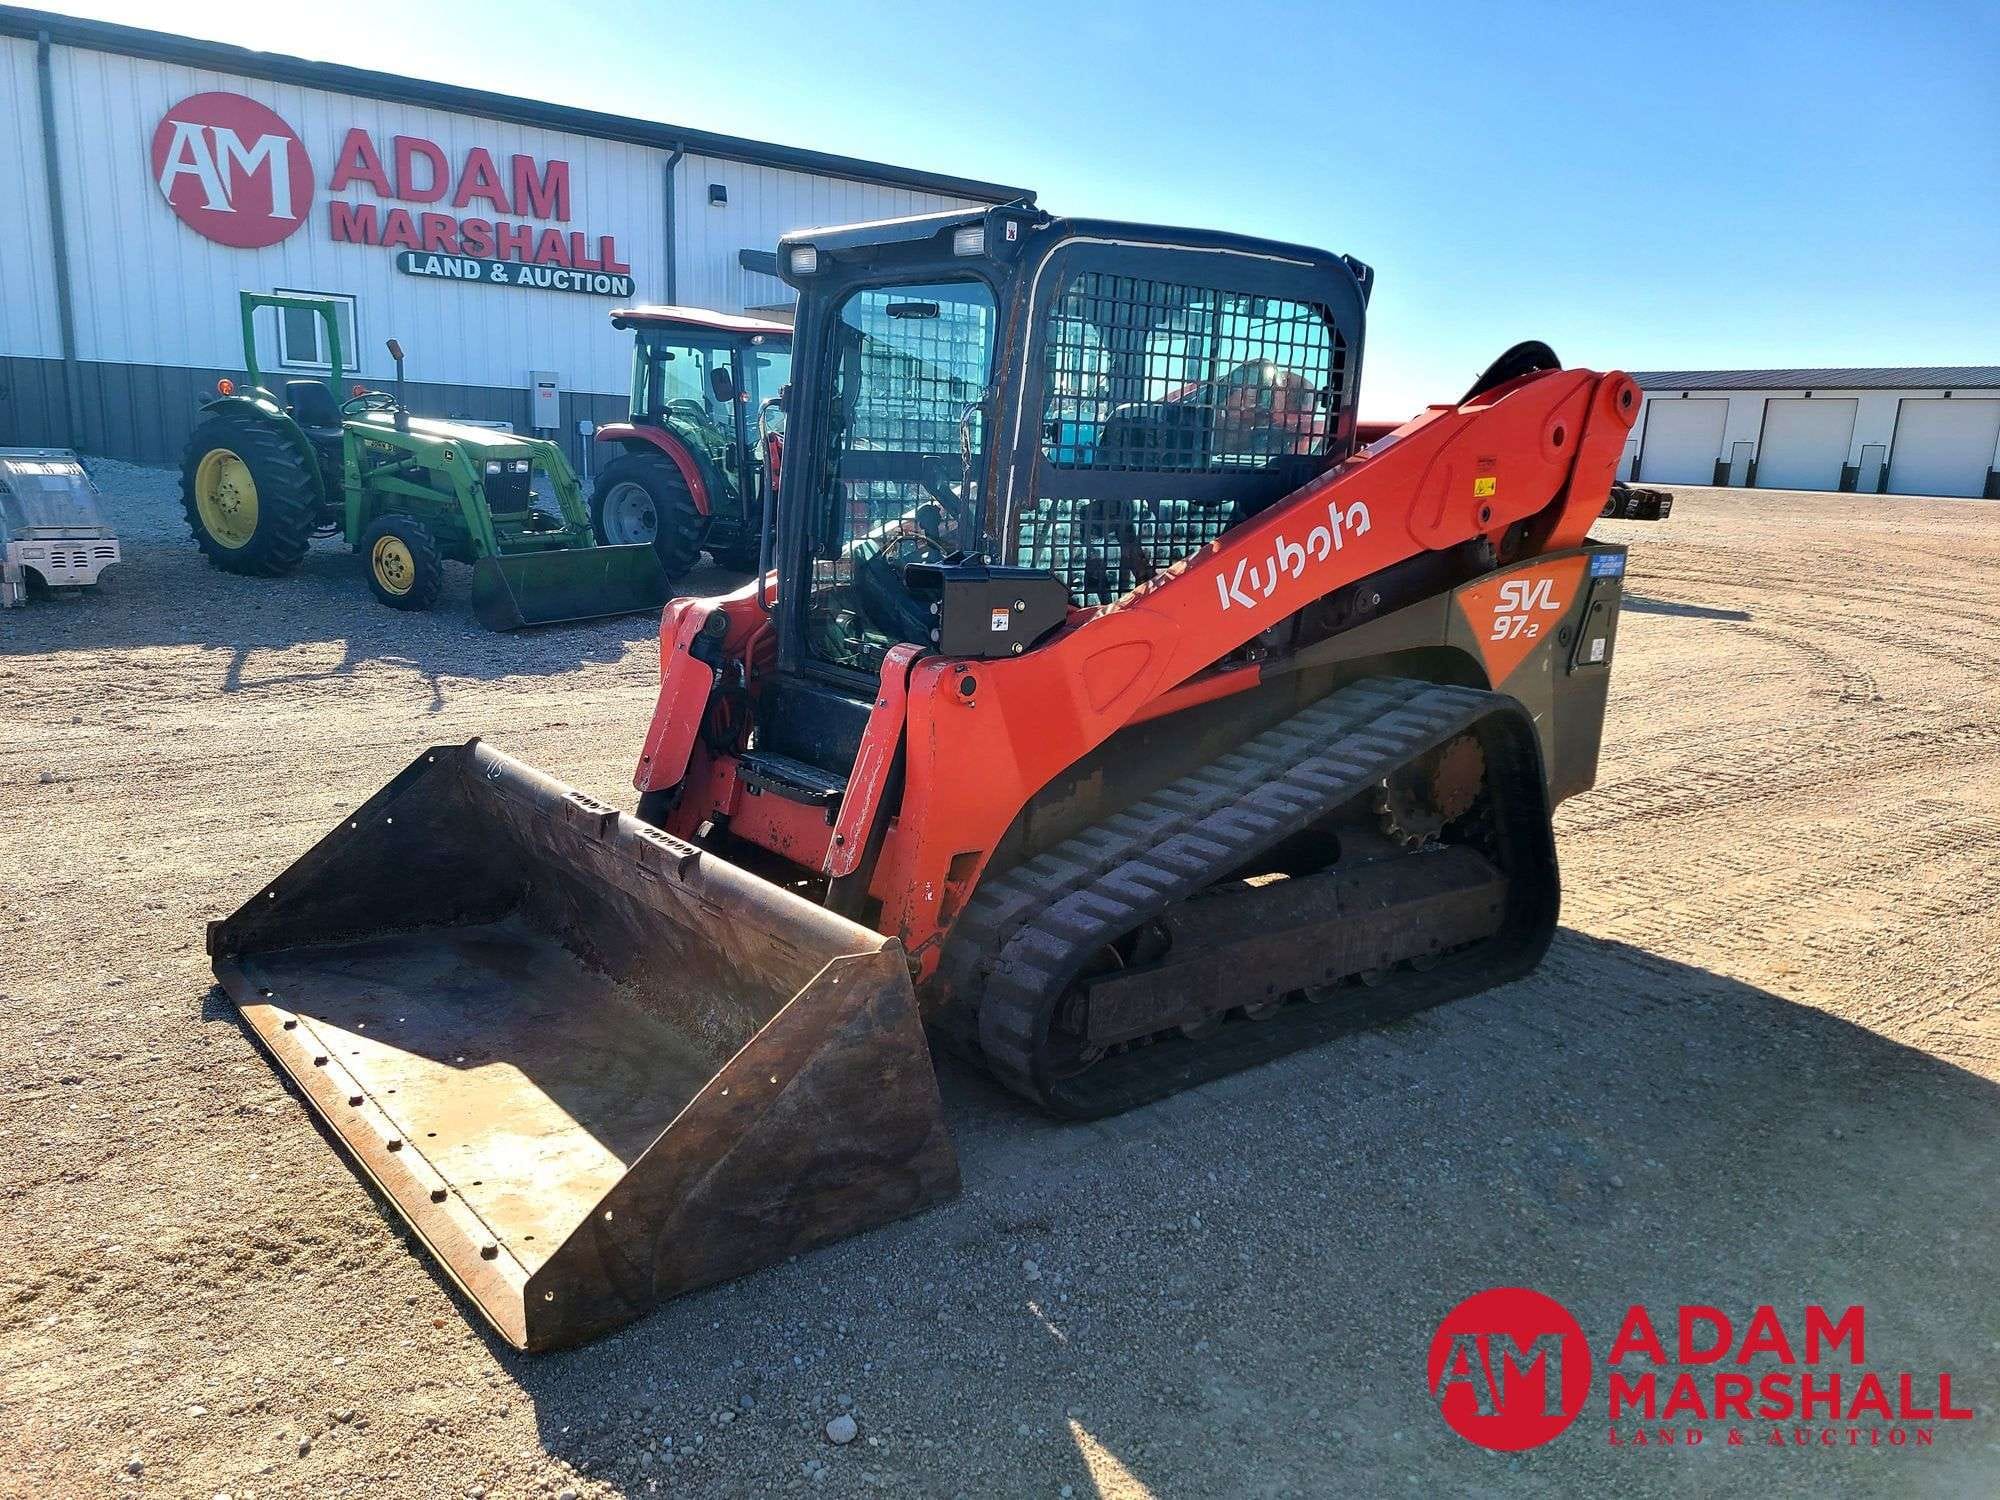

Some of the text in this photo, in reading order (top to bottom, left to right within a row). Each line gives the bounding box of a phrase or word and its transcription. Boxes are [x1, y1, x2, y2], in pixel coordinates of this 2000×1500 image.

[159, 120, 297, 220] AM
[329, 127, 571, 222] ADAM
[329, 200, 631, 274] MARSHALL
[408, 253, 629, 297] LAND & AUCTION
[1216, 501, 1372, 611] Kubota
[1490, 615, 1540, 641] 97-2
[1494, 579, 1561, 613] SVL
